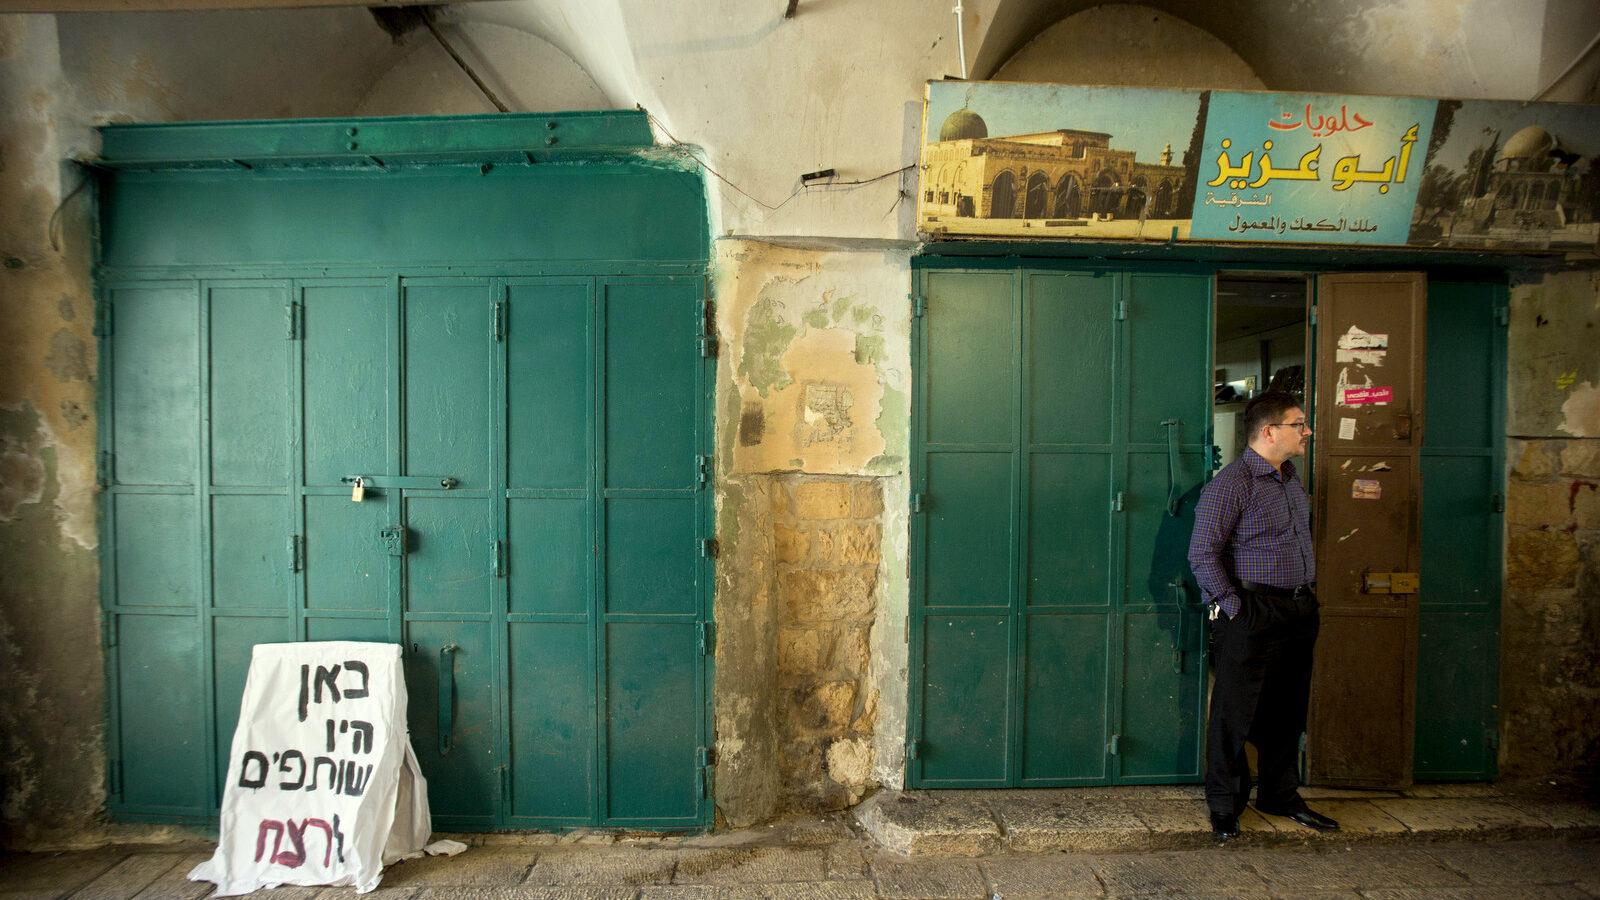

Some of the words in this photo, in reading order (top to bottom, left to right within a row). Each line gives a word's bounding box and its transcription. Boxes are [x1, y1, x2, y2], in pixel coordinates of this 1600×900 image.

[1268, 102, 1374, 137] حلويات
[1206, 138, 1322, 190] عزيز
[1332, 122, 1420, 194] أبو
[1204, 192, 1272, 208] الشرقية
[1228, 213, 1287, 234] والمعمول
[1289, 215, 1347, 232] الكعك
[1348, 217, 1378, 233] ملك
[298, 660, 370, 722] כאן
[326, 719, 374, 754] היו
[238, 749, 374, 797] שותפים
